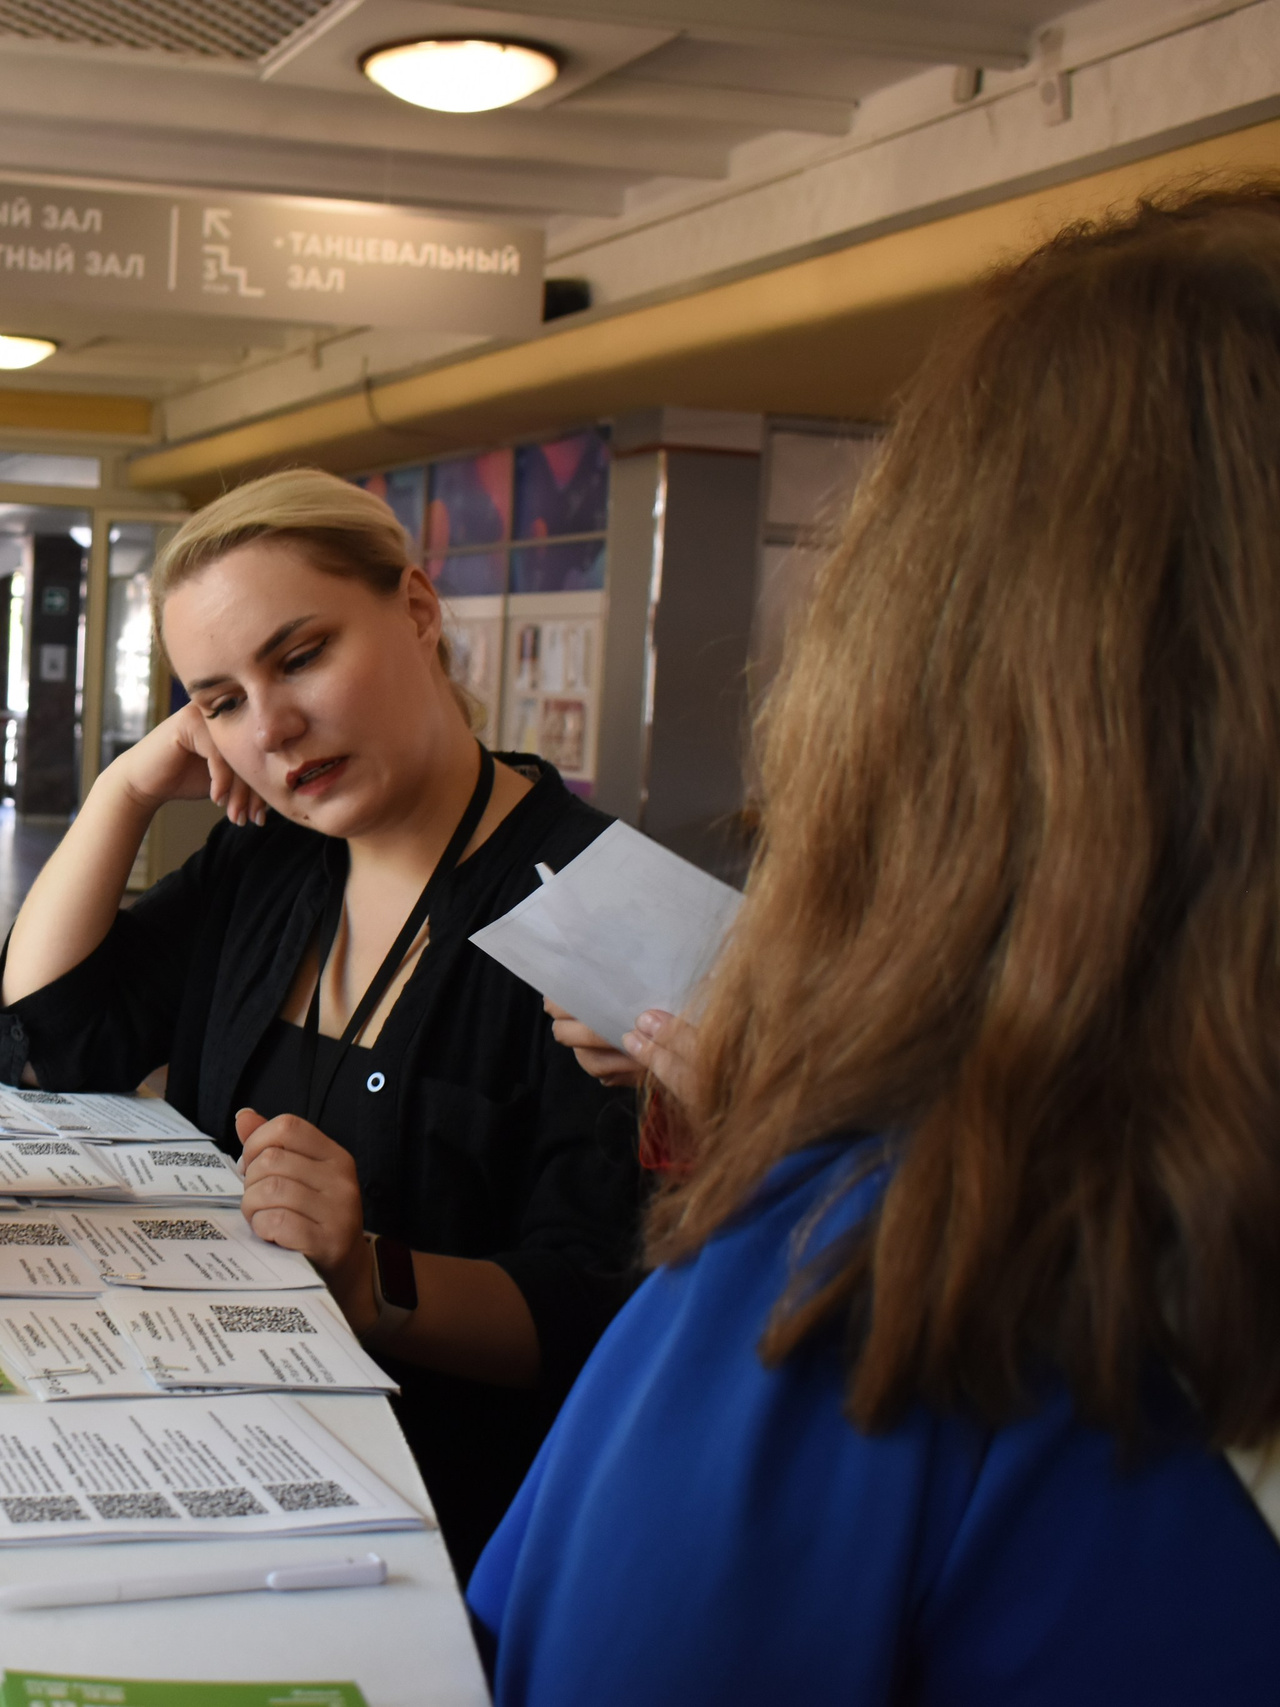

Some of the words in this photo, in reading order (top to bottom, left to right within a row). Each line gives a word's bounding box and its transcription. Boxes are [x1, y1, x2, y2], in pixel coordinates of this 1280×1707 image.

[41, 204, 103, 234] ЗАЛ
[85, 251, 145, 280] ЗАЛ
[288, 231, 520, 276] ТАНЦЕВАЛЬНЫЙ
[203, 258, 218, 282] 3
[287, 265, 345, 294] ЗАЛ
